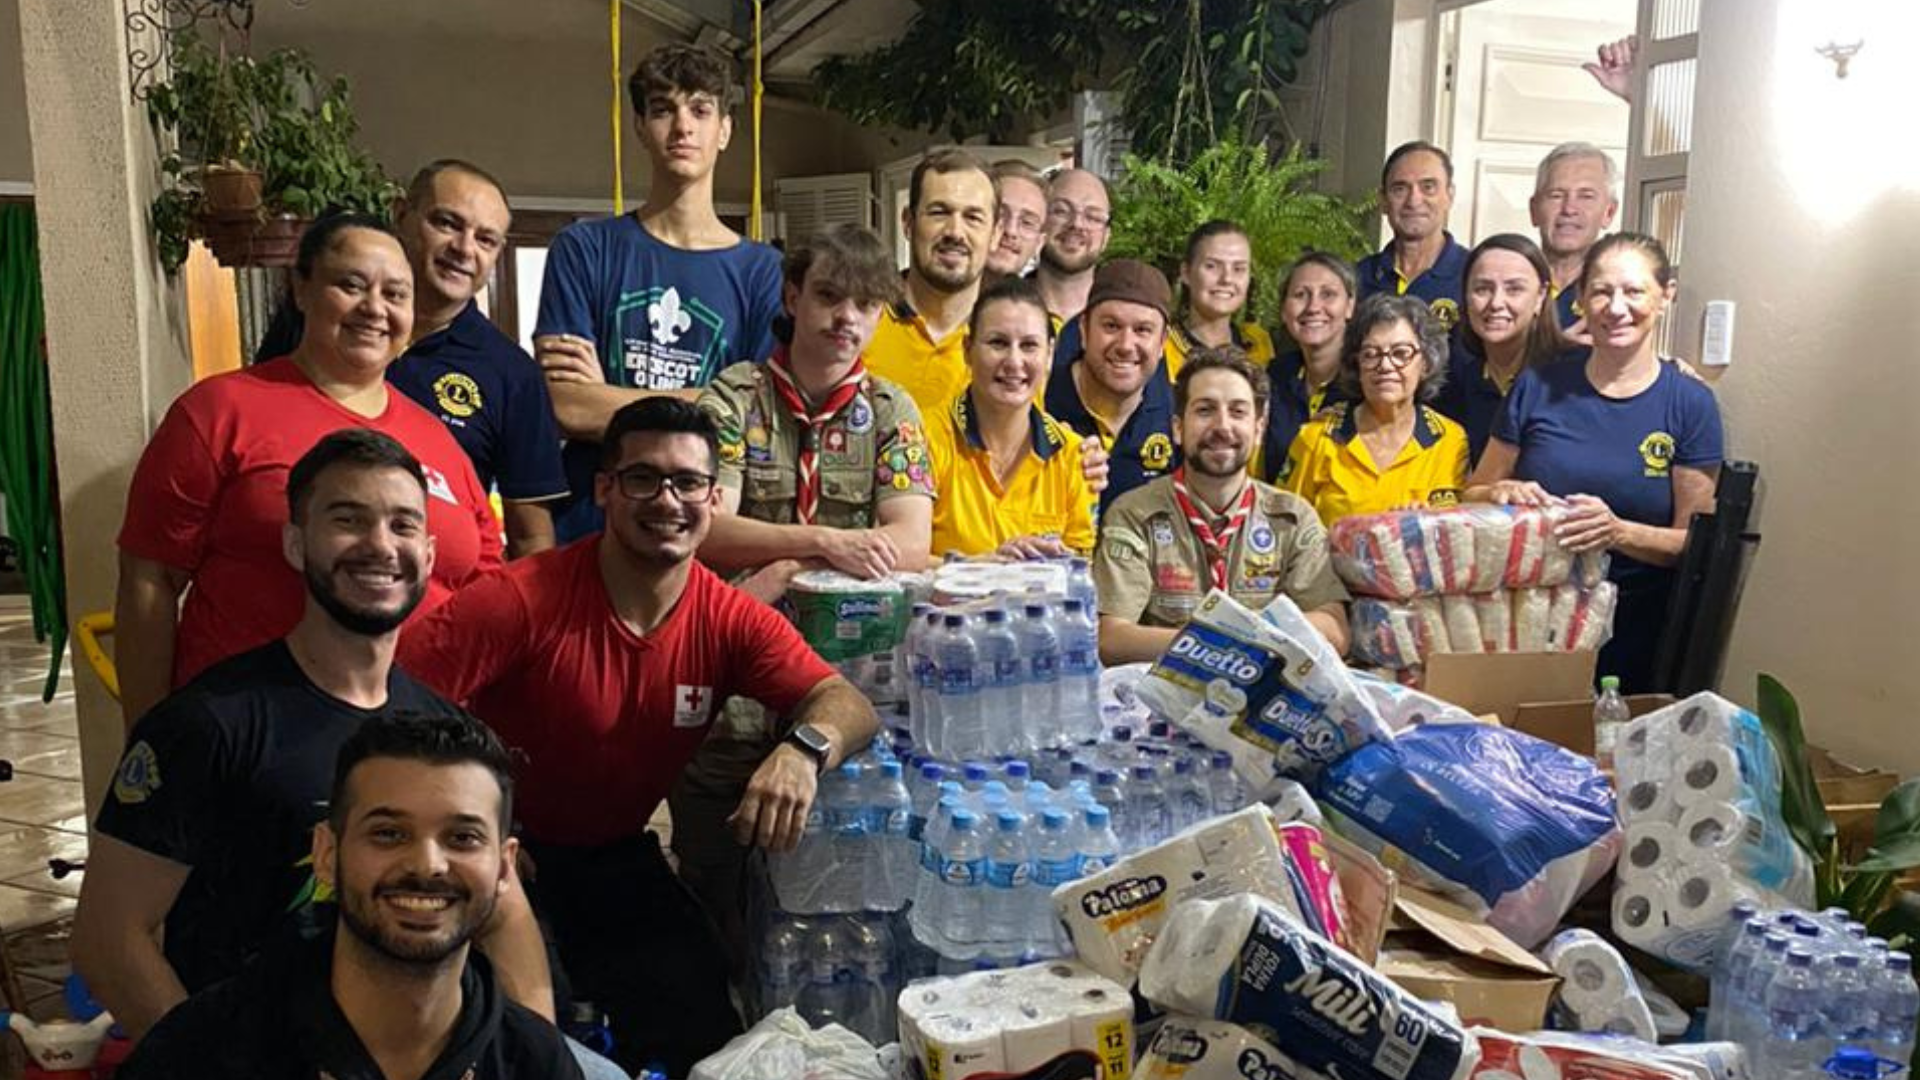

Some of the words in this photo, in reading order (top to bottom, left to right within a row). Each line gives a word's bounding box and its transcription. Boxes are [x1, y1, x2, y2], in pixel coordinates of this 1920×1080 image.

[1172, 635, 1258, 681] Duetto
[1251, 952, 1281, 992] FOLHA
[1283, 969, 1377, 1035] Mili
[1105, 1033, 1123, 1049] 12
[1395, 1011, 1425, 1046] 60
